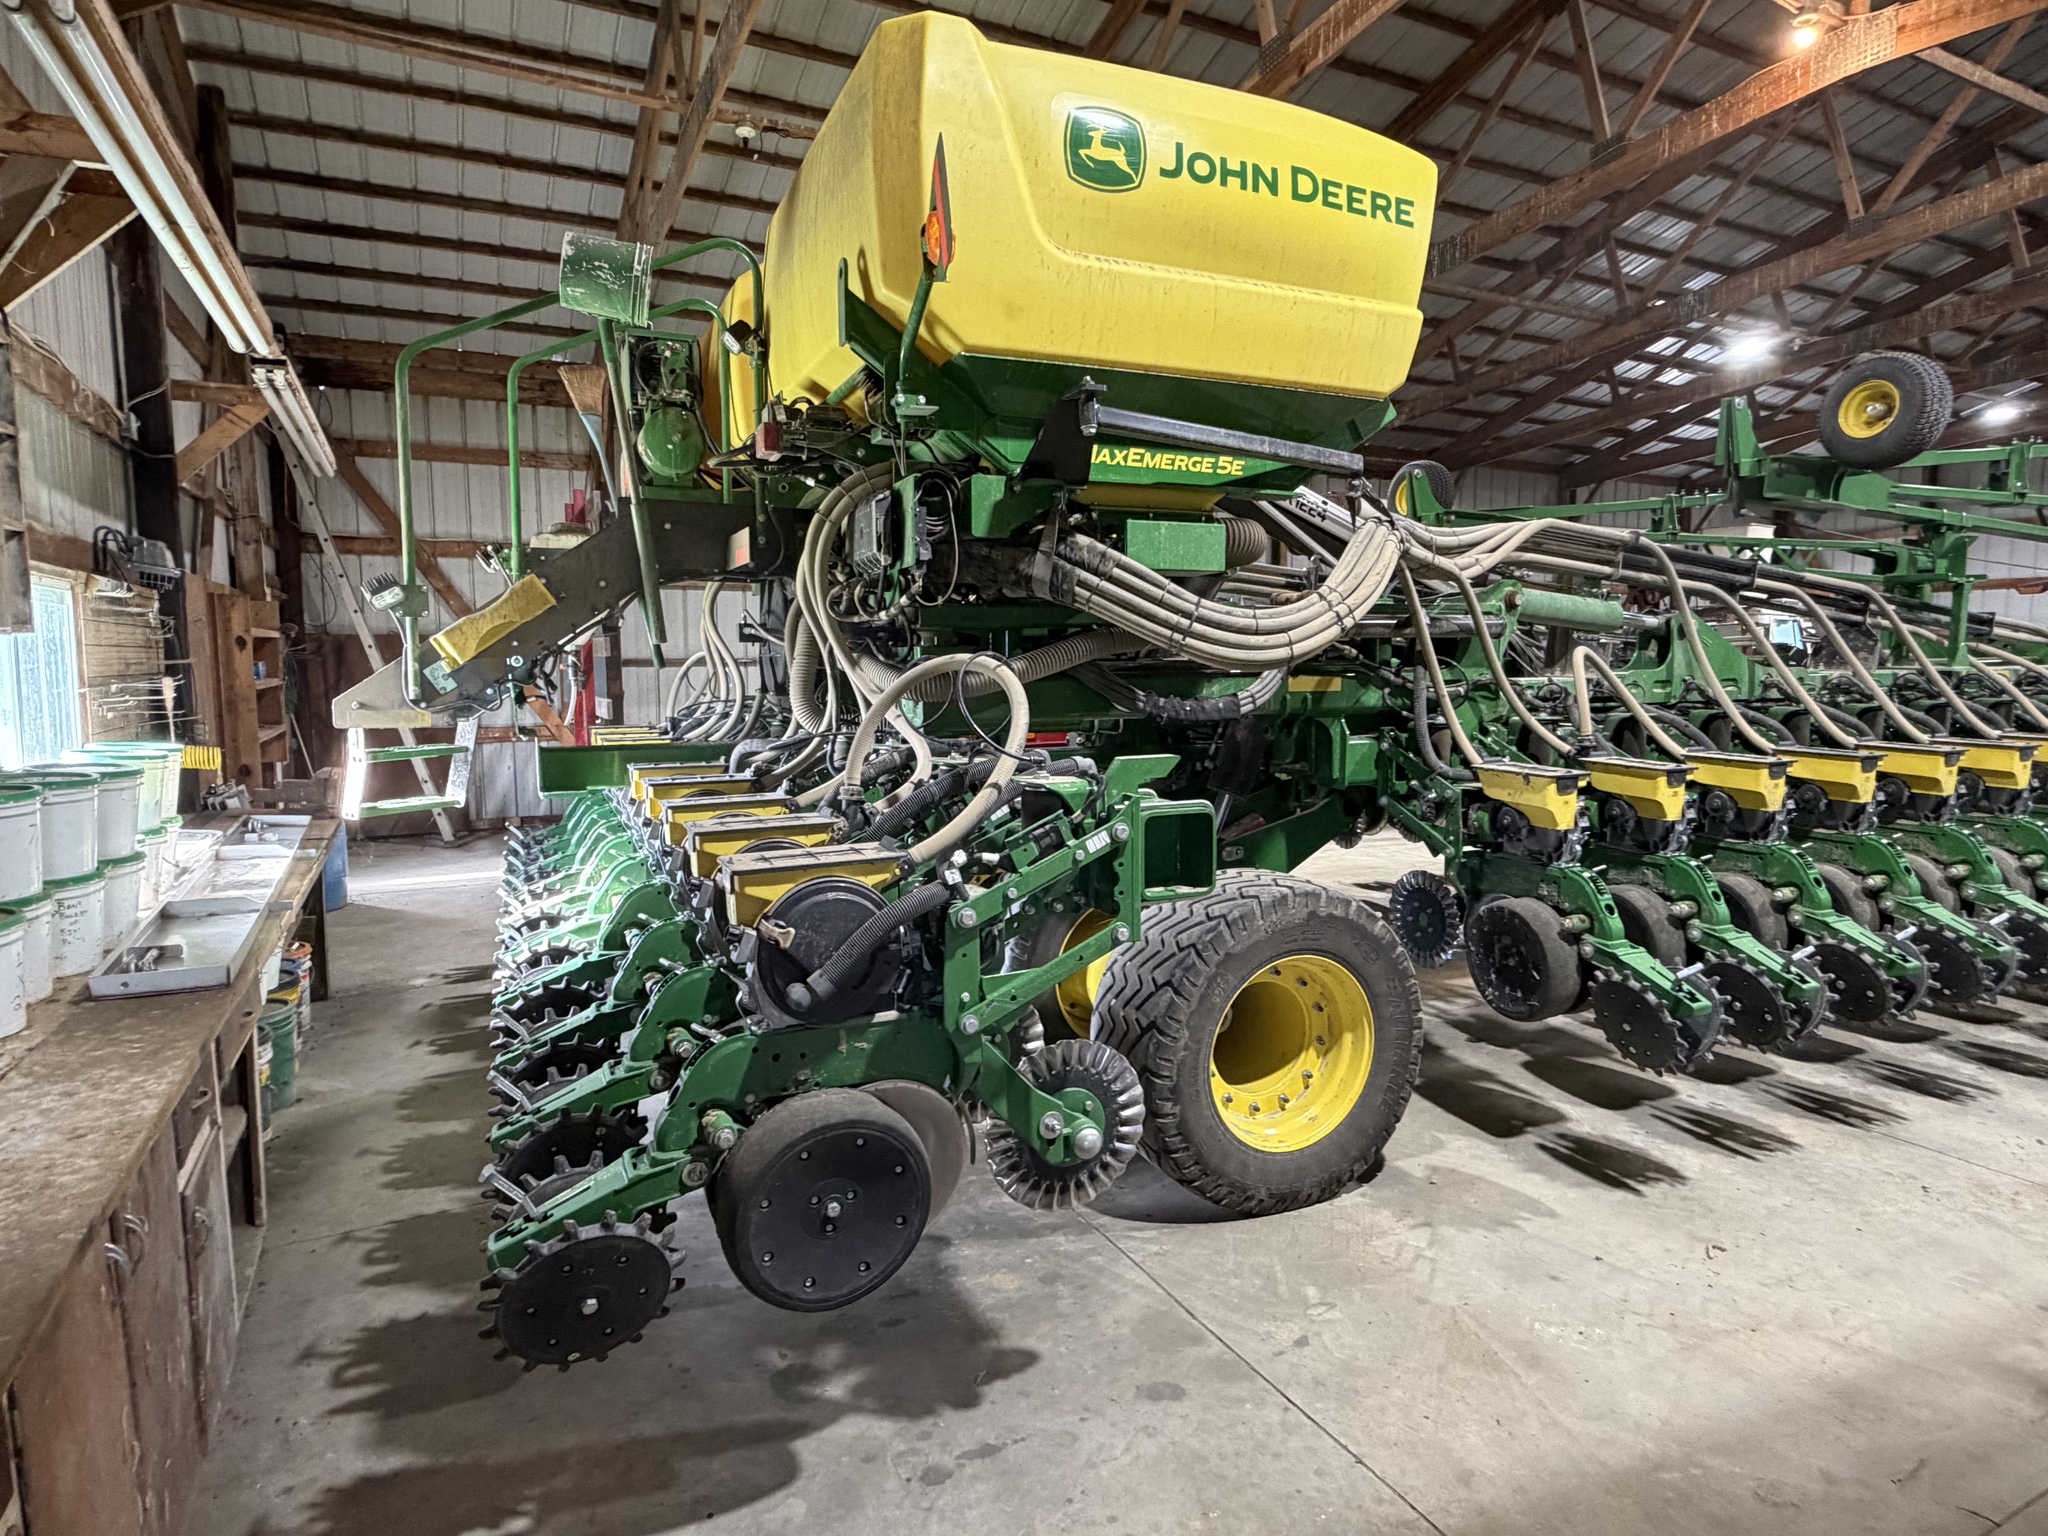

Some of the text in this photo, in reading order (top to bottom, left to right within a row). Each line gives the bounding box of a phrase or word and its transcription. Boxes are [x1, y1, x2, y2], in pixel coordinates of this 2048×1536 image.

[1159, 142, 1415, 228] JOHN DEERE
[1216, 456, 1246, 476] 5E
